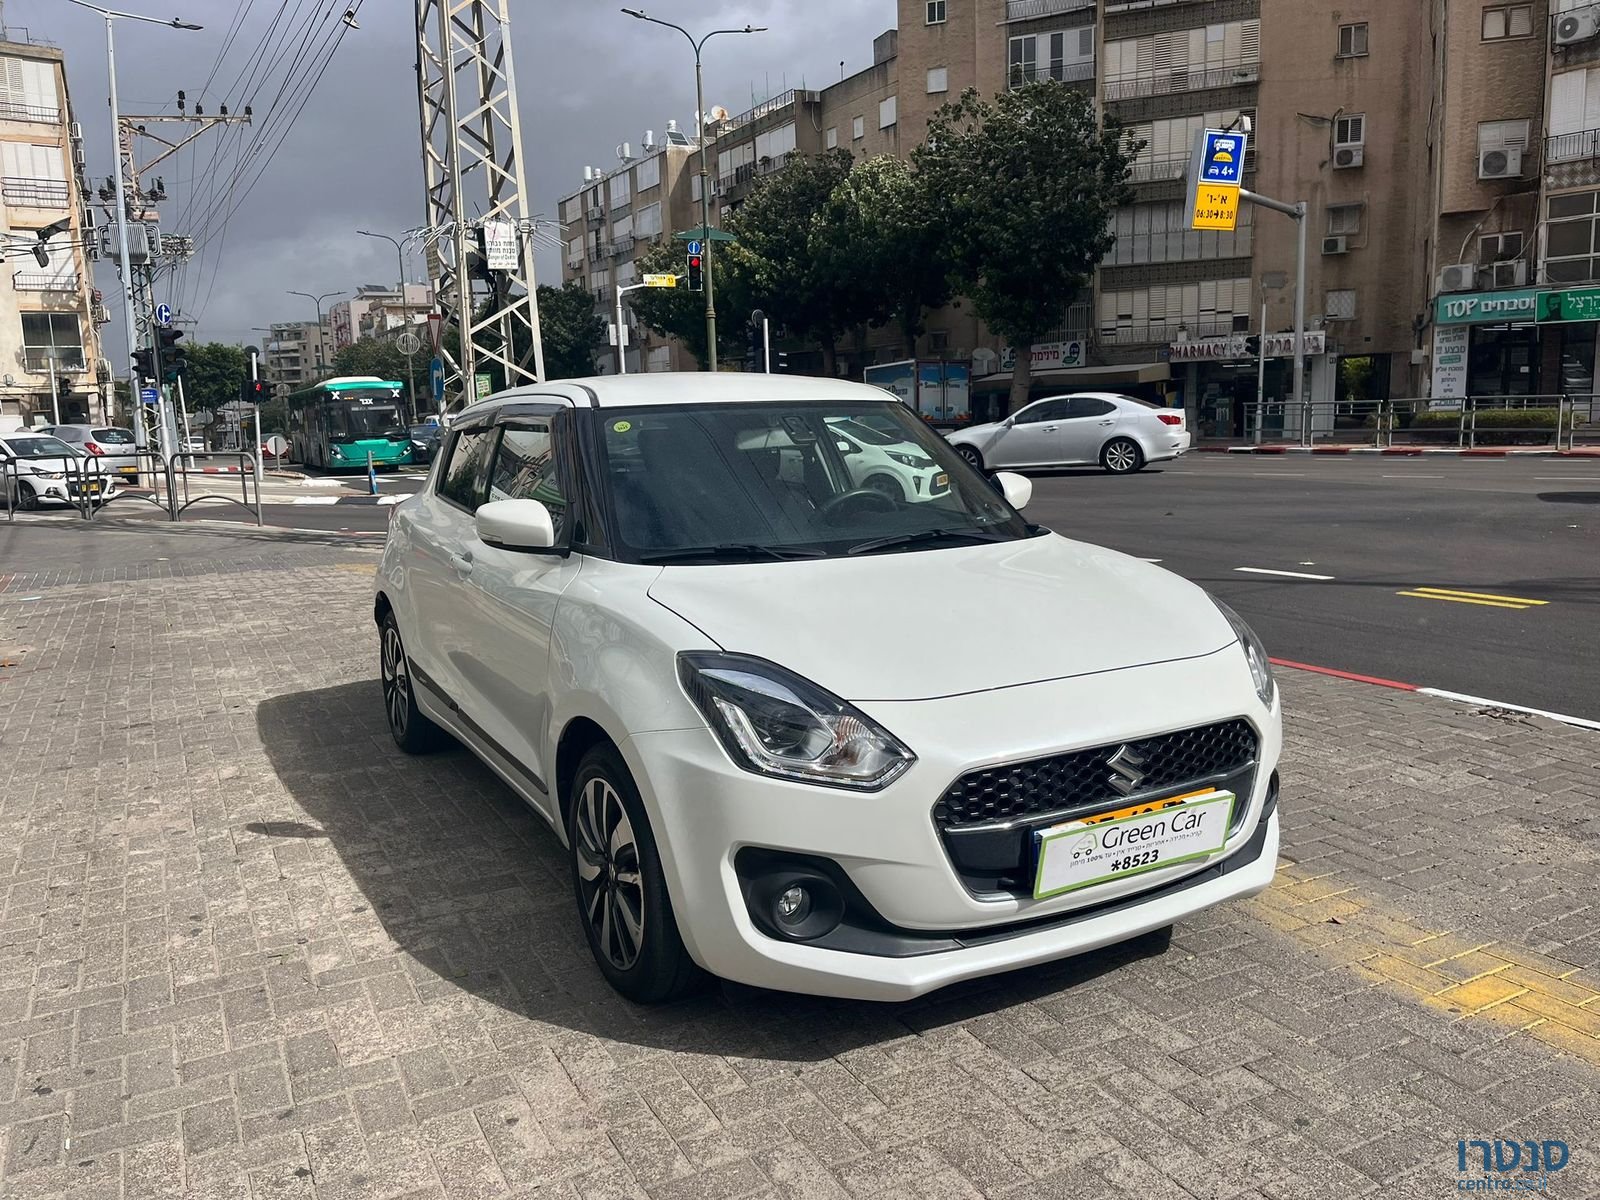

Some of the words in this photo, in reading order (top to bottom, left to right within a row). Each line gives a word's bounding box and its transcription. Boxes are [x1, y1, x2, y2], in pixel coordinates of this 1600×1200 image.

[1221, 166, 1234, 176] 4+
[1444, 298, 1479, 317] TOP
[1168, 343, 1227, 358] PHARMACY
[1102, 821, 1166, 849] Green
[1171, 811, 1207, 832] Car
[1086, 854, 1104, 863] 100%
